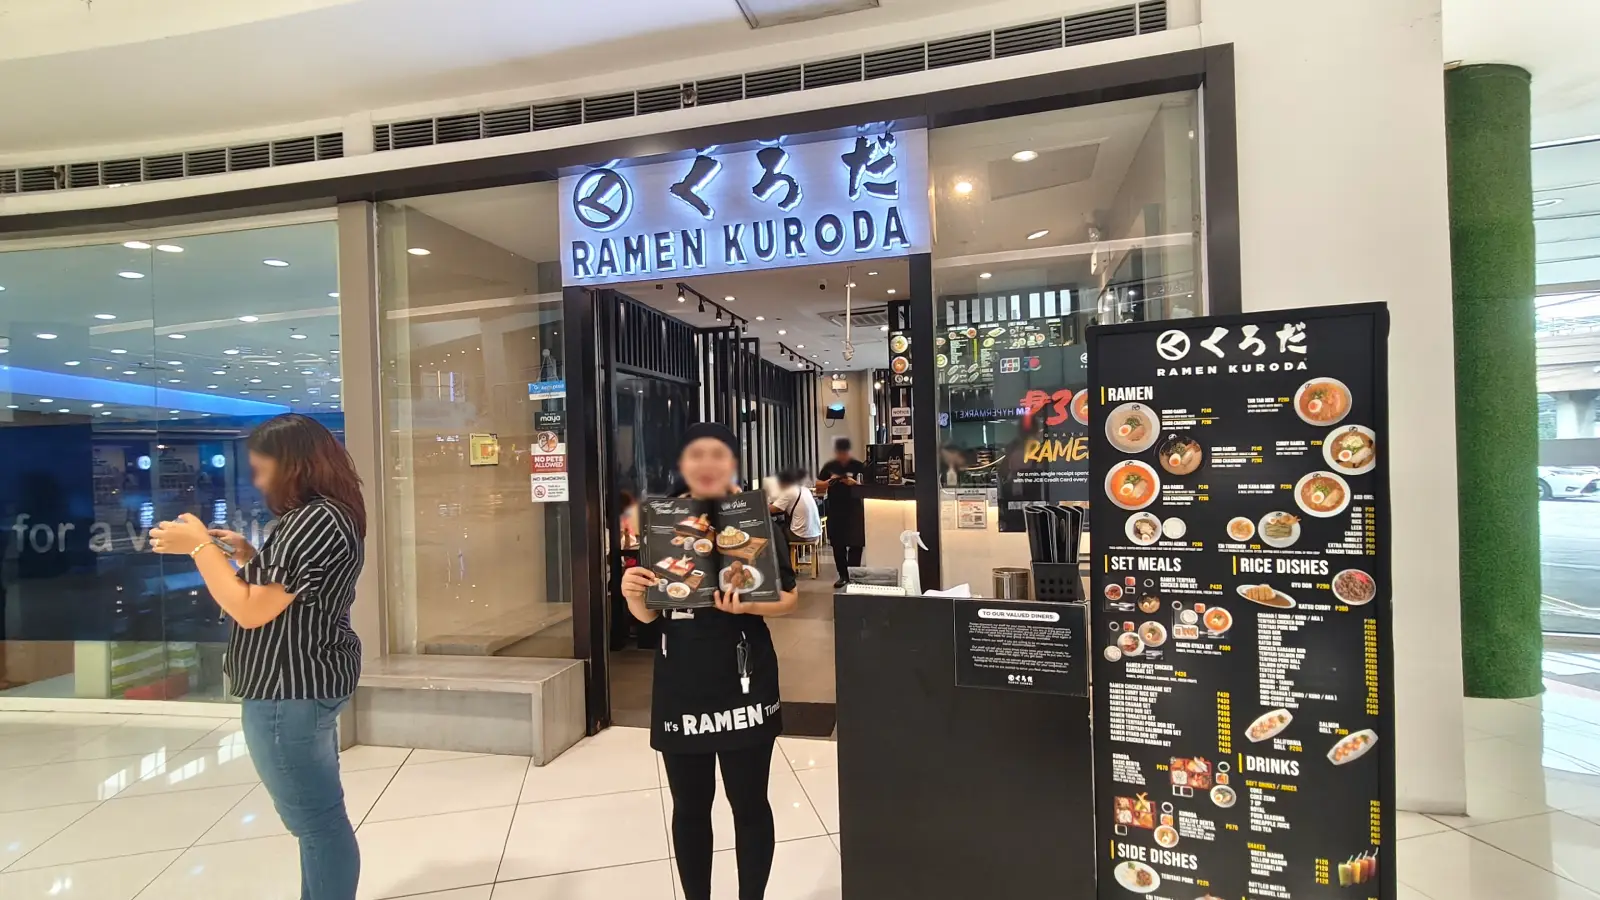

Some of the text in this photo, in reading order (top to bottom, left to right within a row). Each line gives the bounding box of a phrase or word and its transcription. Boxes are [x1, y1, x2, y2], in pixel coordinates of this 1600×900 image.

[572, 207, 911, 279] RAMEN KURODA
[1200, 321, 1307, 358] くろだ
[1156, 361, 1307, 377] RAMEN KURODA
[1108, 386, 1153, 402] RAMEN
[1024, 437, 1089, 463] RAME
[11, 513, 76, 555] for
[88, 522, 113, 553] a
[1111, 556, 1182, 572] SET MEALS
[1240, 558, 1329, 575] RICE DISHES
[664, 721, 679, 732] It's
[682, 703, 764, 736] RAMEN
[1246, 755, 1300, 777] DRINKS
[1118, 843, 1198, 870] SIDE DISHES
